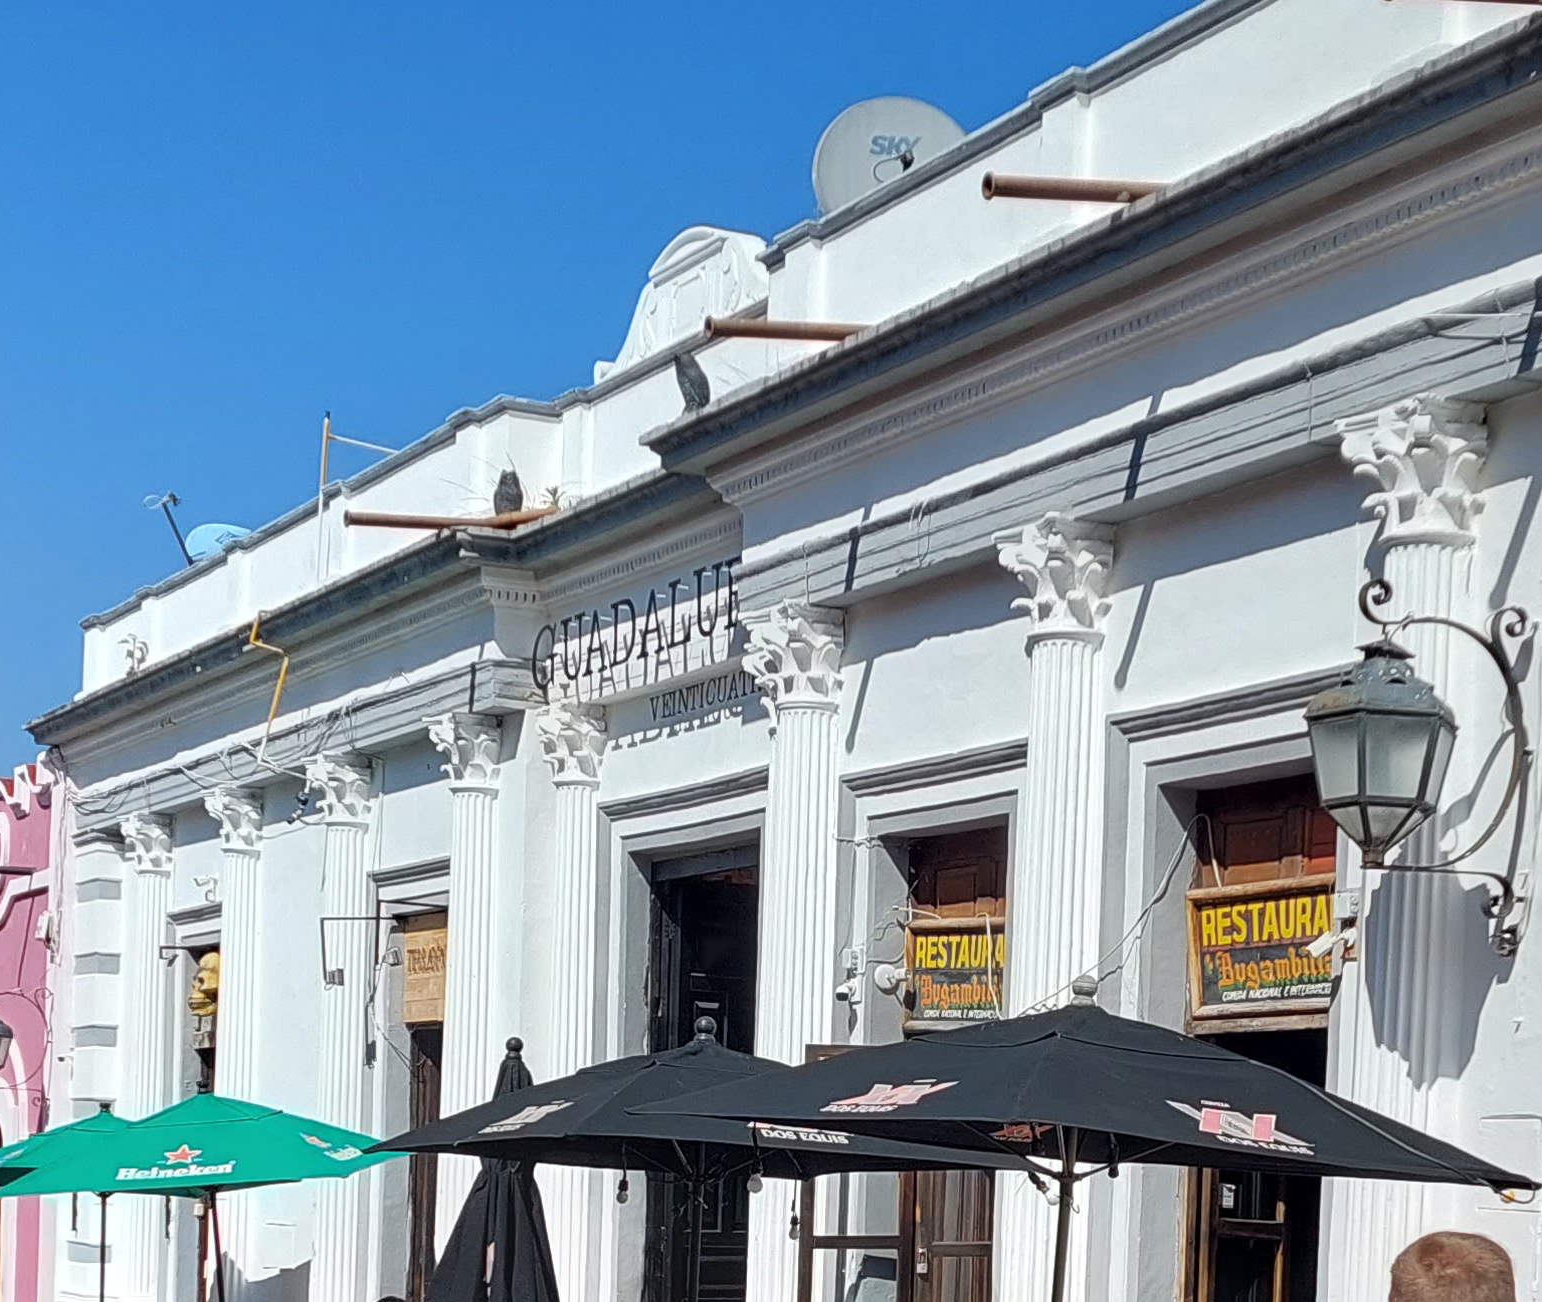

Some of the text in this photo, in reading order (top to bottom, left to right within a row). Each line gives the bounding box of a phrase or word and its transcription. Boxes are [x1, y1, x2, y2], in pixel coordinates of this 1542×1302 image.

[869, 135, 922, 156] SKY
[761, 1129, 850, 1144] DOS EQUIS
[115, 1159, 235, 1181] Heineken
